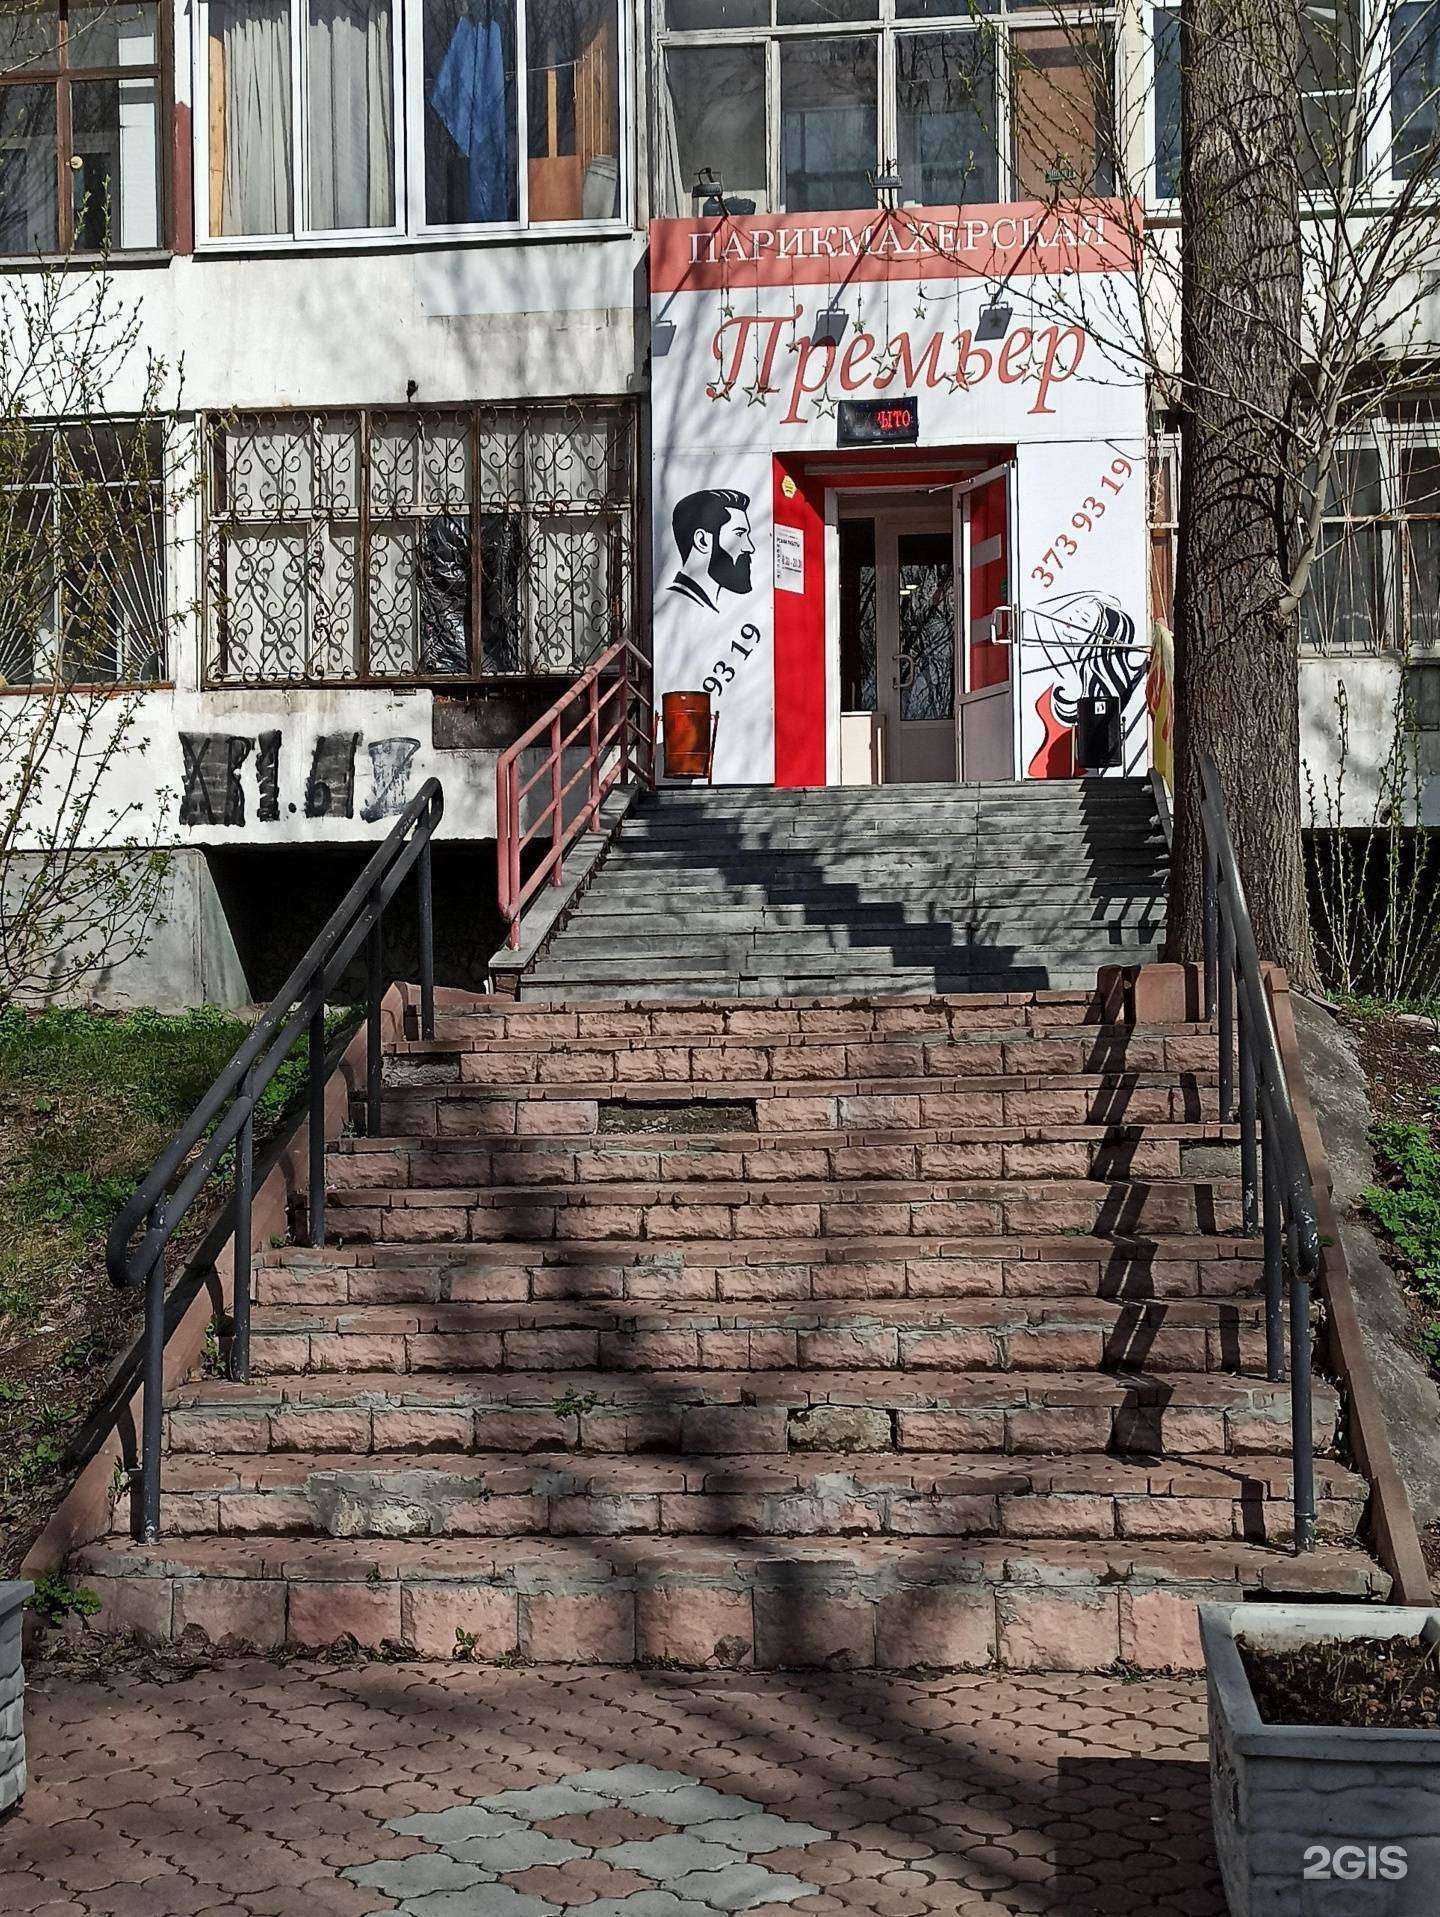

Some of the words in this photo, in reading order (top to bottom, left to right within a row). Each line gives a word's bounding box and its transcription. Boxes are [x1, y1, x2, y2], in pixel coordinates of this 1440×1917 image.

[688, 213, 1111, 263] ПАРИКМАХЕРСКАЯ
[705, 303, 1086, 424] Премьер
[1030, 534, 1078, 588] 373
[1071, 496, 1106, 532] 93
[1101, 458, 1132, 496] 19
[702, 660, 736, 697] 93
[731, 623, 761, 661] 19
